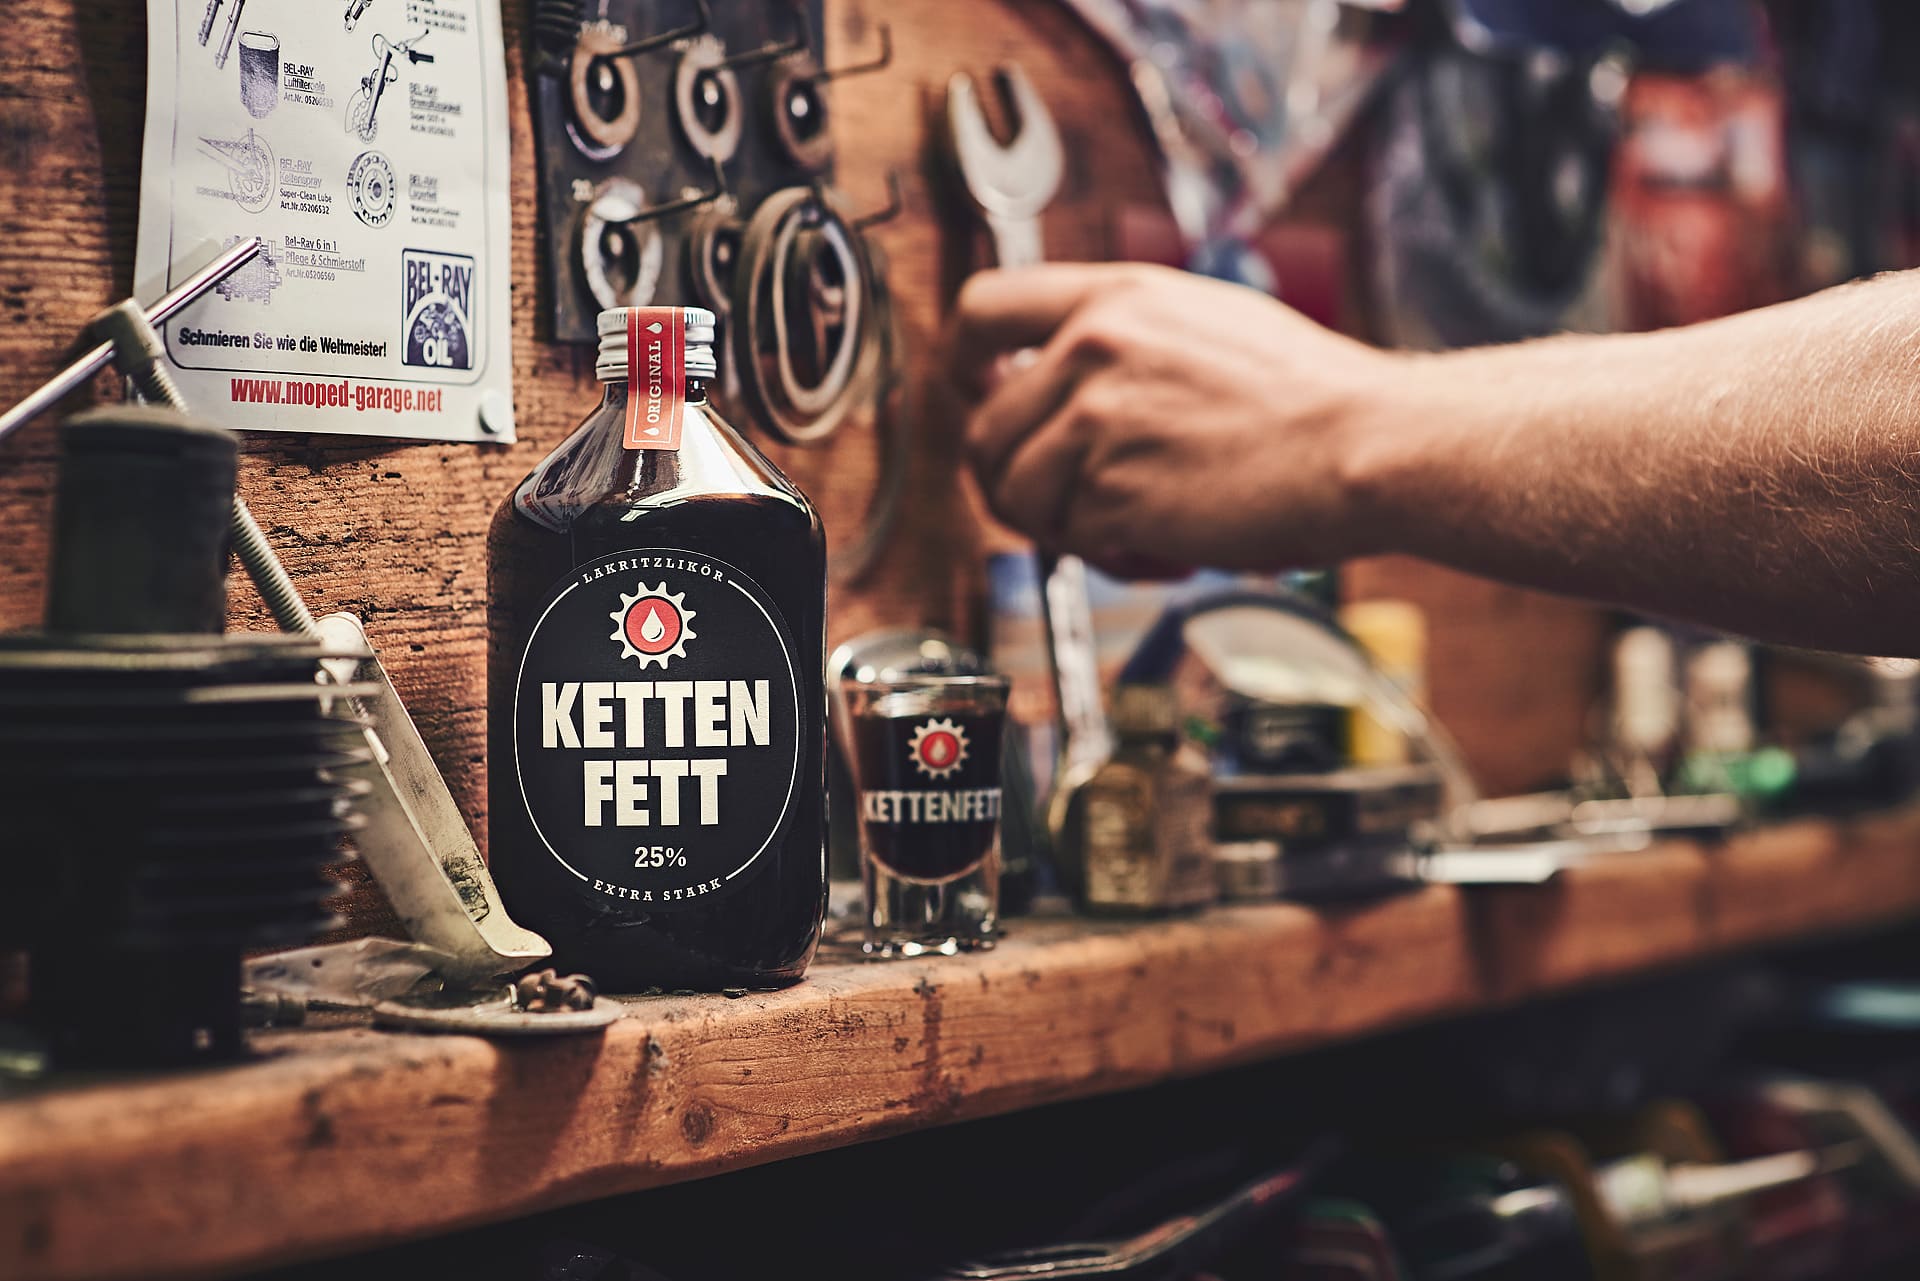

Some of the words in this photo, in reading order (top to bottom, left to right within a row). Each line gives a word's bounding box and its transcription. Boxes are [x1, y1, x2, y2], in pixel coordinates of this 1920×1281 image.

[284, 62, 314, 76] BEL-RAY
[280, 158, 312, 171] BEL-RAY
[280, 188, 316, 200] Super-Clean
[318, 193, 332, 203] Lube
[281, 201, 330, 214] Art.Nr.05206532
[285, 235, 314, 249] Bel-Ray
[323, 240, 330, 251] in
[285, 251, 309, 265] Pflege
[311, 254, 316, 265] &
[318, 254, 366, 271] Schmierstoff
[179, 327, 250, 348] Schmieren
[253, 332, 273, 350] Sie
[277, 334, 297, 351] wie
[299, 335, 318, 353] die
[319, 337, 387, 358] Weltmeister!
[646, 340, 662, 423] ORIGINAL
[231, 378, 443, 413] www.moped-garage.net
[582, 557, 724, 584] LAKRITZLIKÖR
[542, 680, 770, 748] KETTEN
[584, 759, 728, 826] FETT
[634, 846, 687, 868] 25%
[593, 879, 653, 902] EXTRA
[663, 878, 723, 900] STARK
